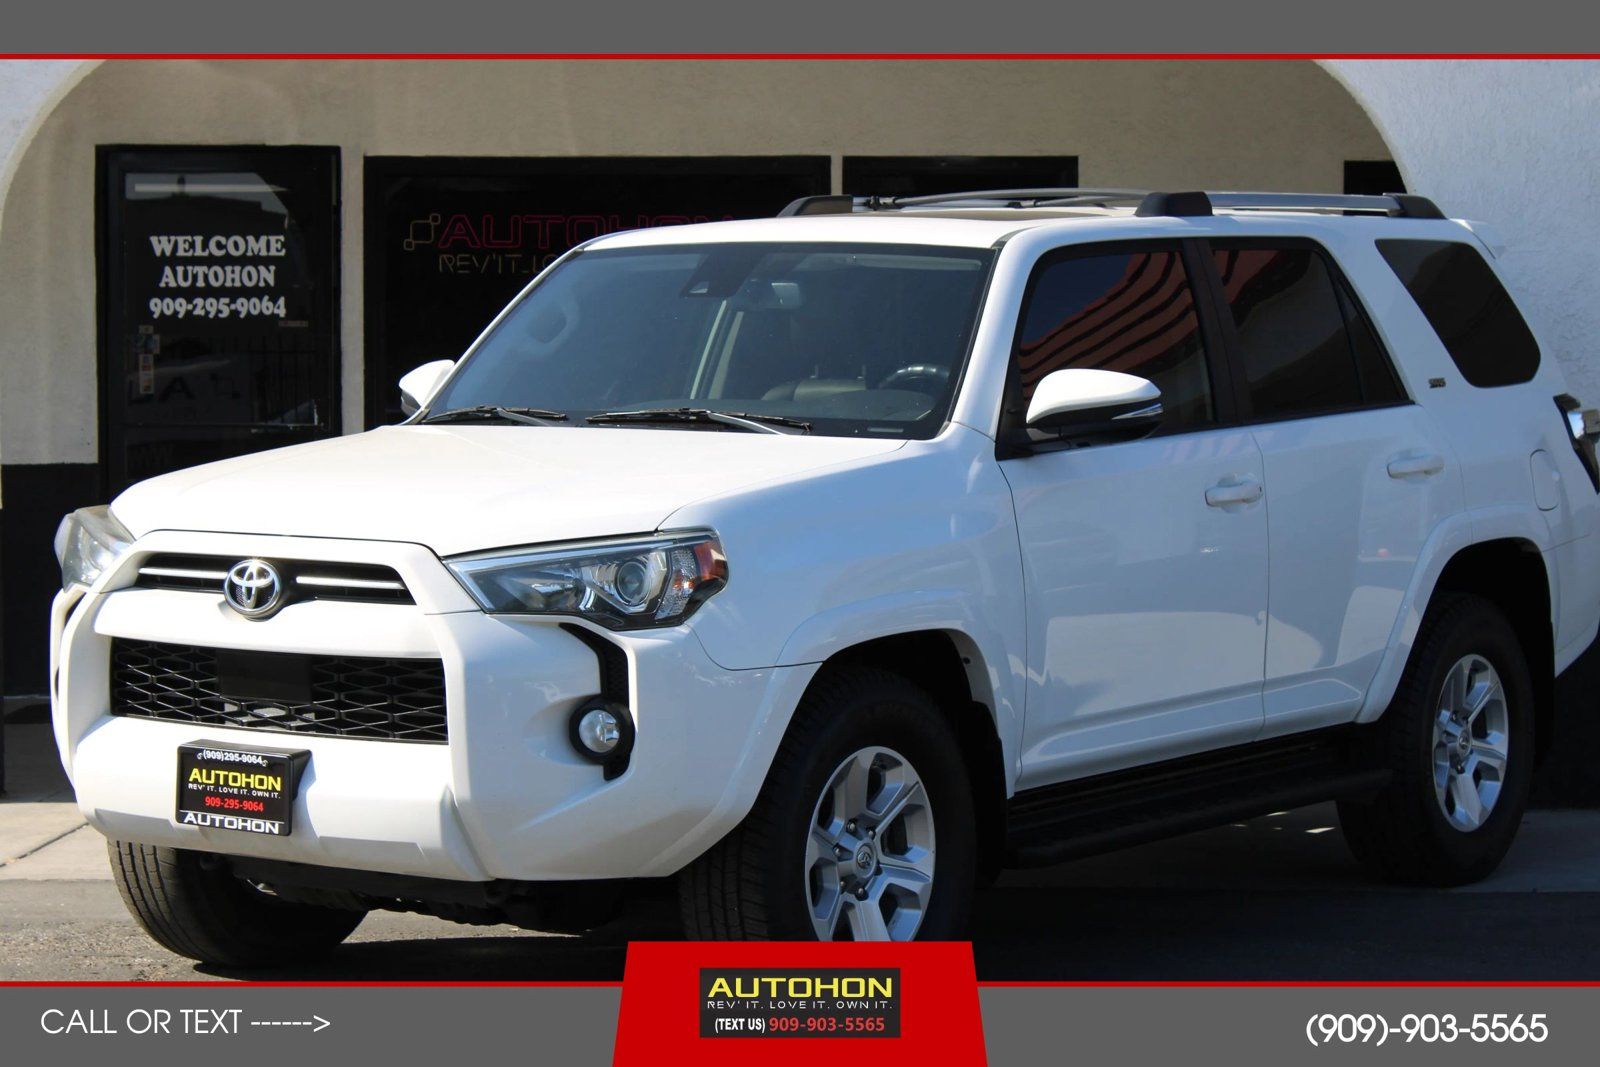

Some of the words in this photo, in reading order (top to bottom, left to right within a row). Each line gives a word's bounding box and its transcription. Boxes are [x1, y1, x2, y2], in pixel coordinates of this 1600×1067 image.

[437, 213, 734, 250] AUTO
[149, 235, 286, 257] WELCOME
[158, 265, 277, 288] AUTOHON
[149, 295, 287, 319] 909-295-9064
[188, 767, 281, 791] AUTOHON
[218, 786, 239, 795] LOVE
[251, 790, 270, 798] OWN
[204, 796, 265, 812] 909-295-9064
[183, 812, 279, 834] AUTOHON
